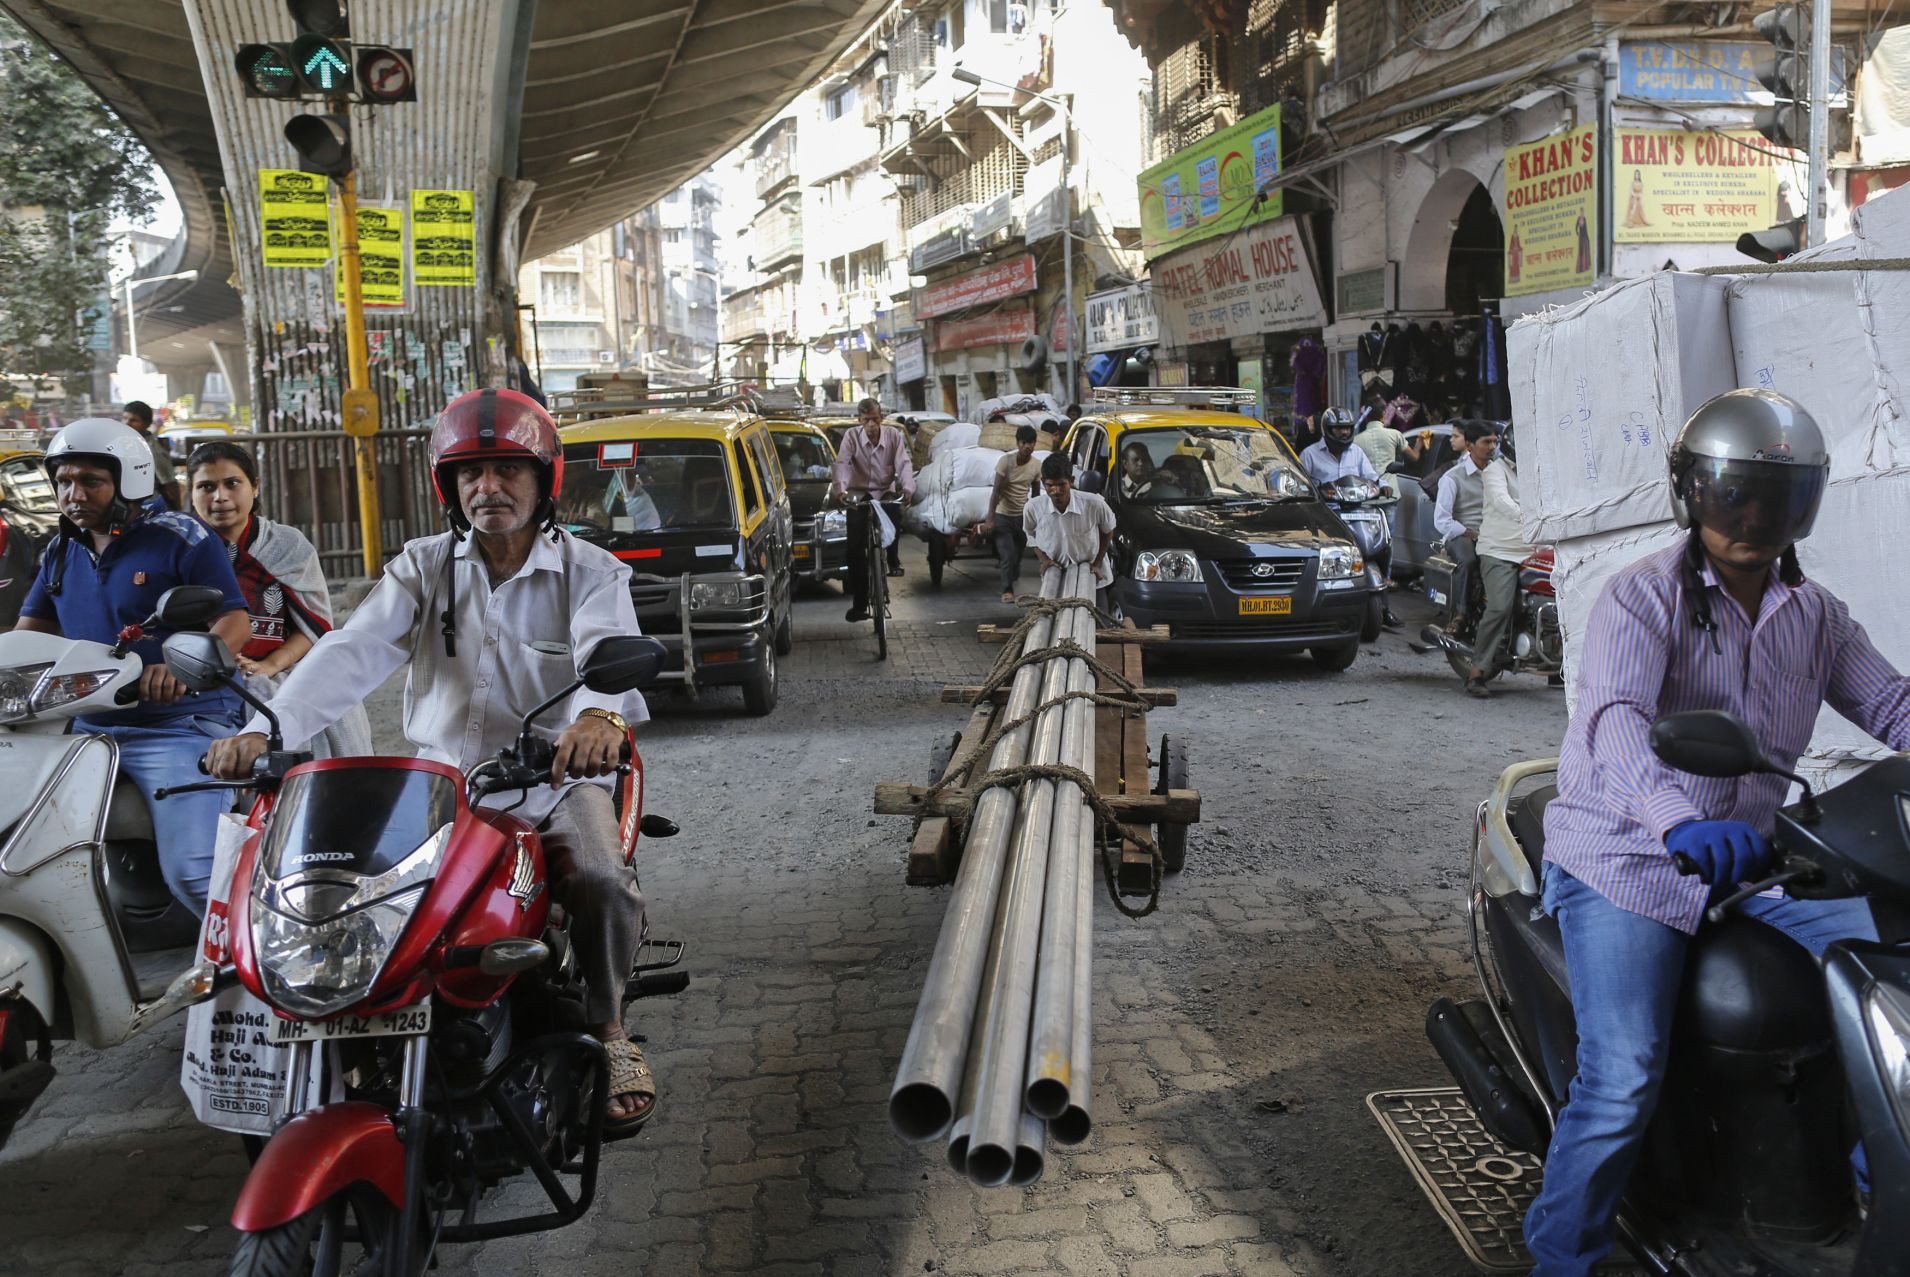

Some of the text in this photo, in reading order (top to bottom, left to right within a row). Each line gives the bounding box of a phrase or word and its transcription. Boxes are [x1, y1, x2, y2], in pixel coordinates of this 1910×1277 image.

[1636, 71, 1714, 90] POPULAR
[1518, 131, 1594, 181] KHAN'S
[1621, 134, 1685, 166] KHAN'S
[1506, 168, 1594, 210] COLLECTION
[1161, 262, 1203, 302] PATEL
[1250, 234, 1299, 279] HOUSE
[291, 852, 355, 865] HONDA
[211, 1010, 270, 1028] Mohd.
[210, 1028, 247, 1047] Haji
[210, 1048, 257, 1064] & Co.
[210, 1064, 236, 1079] Haji
[241, 1066, 277, 1081] Adam
[212, 1098, 267, 1114] ESTD.1905
